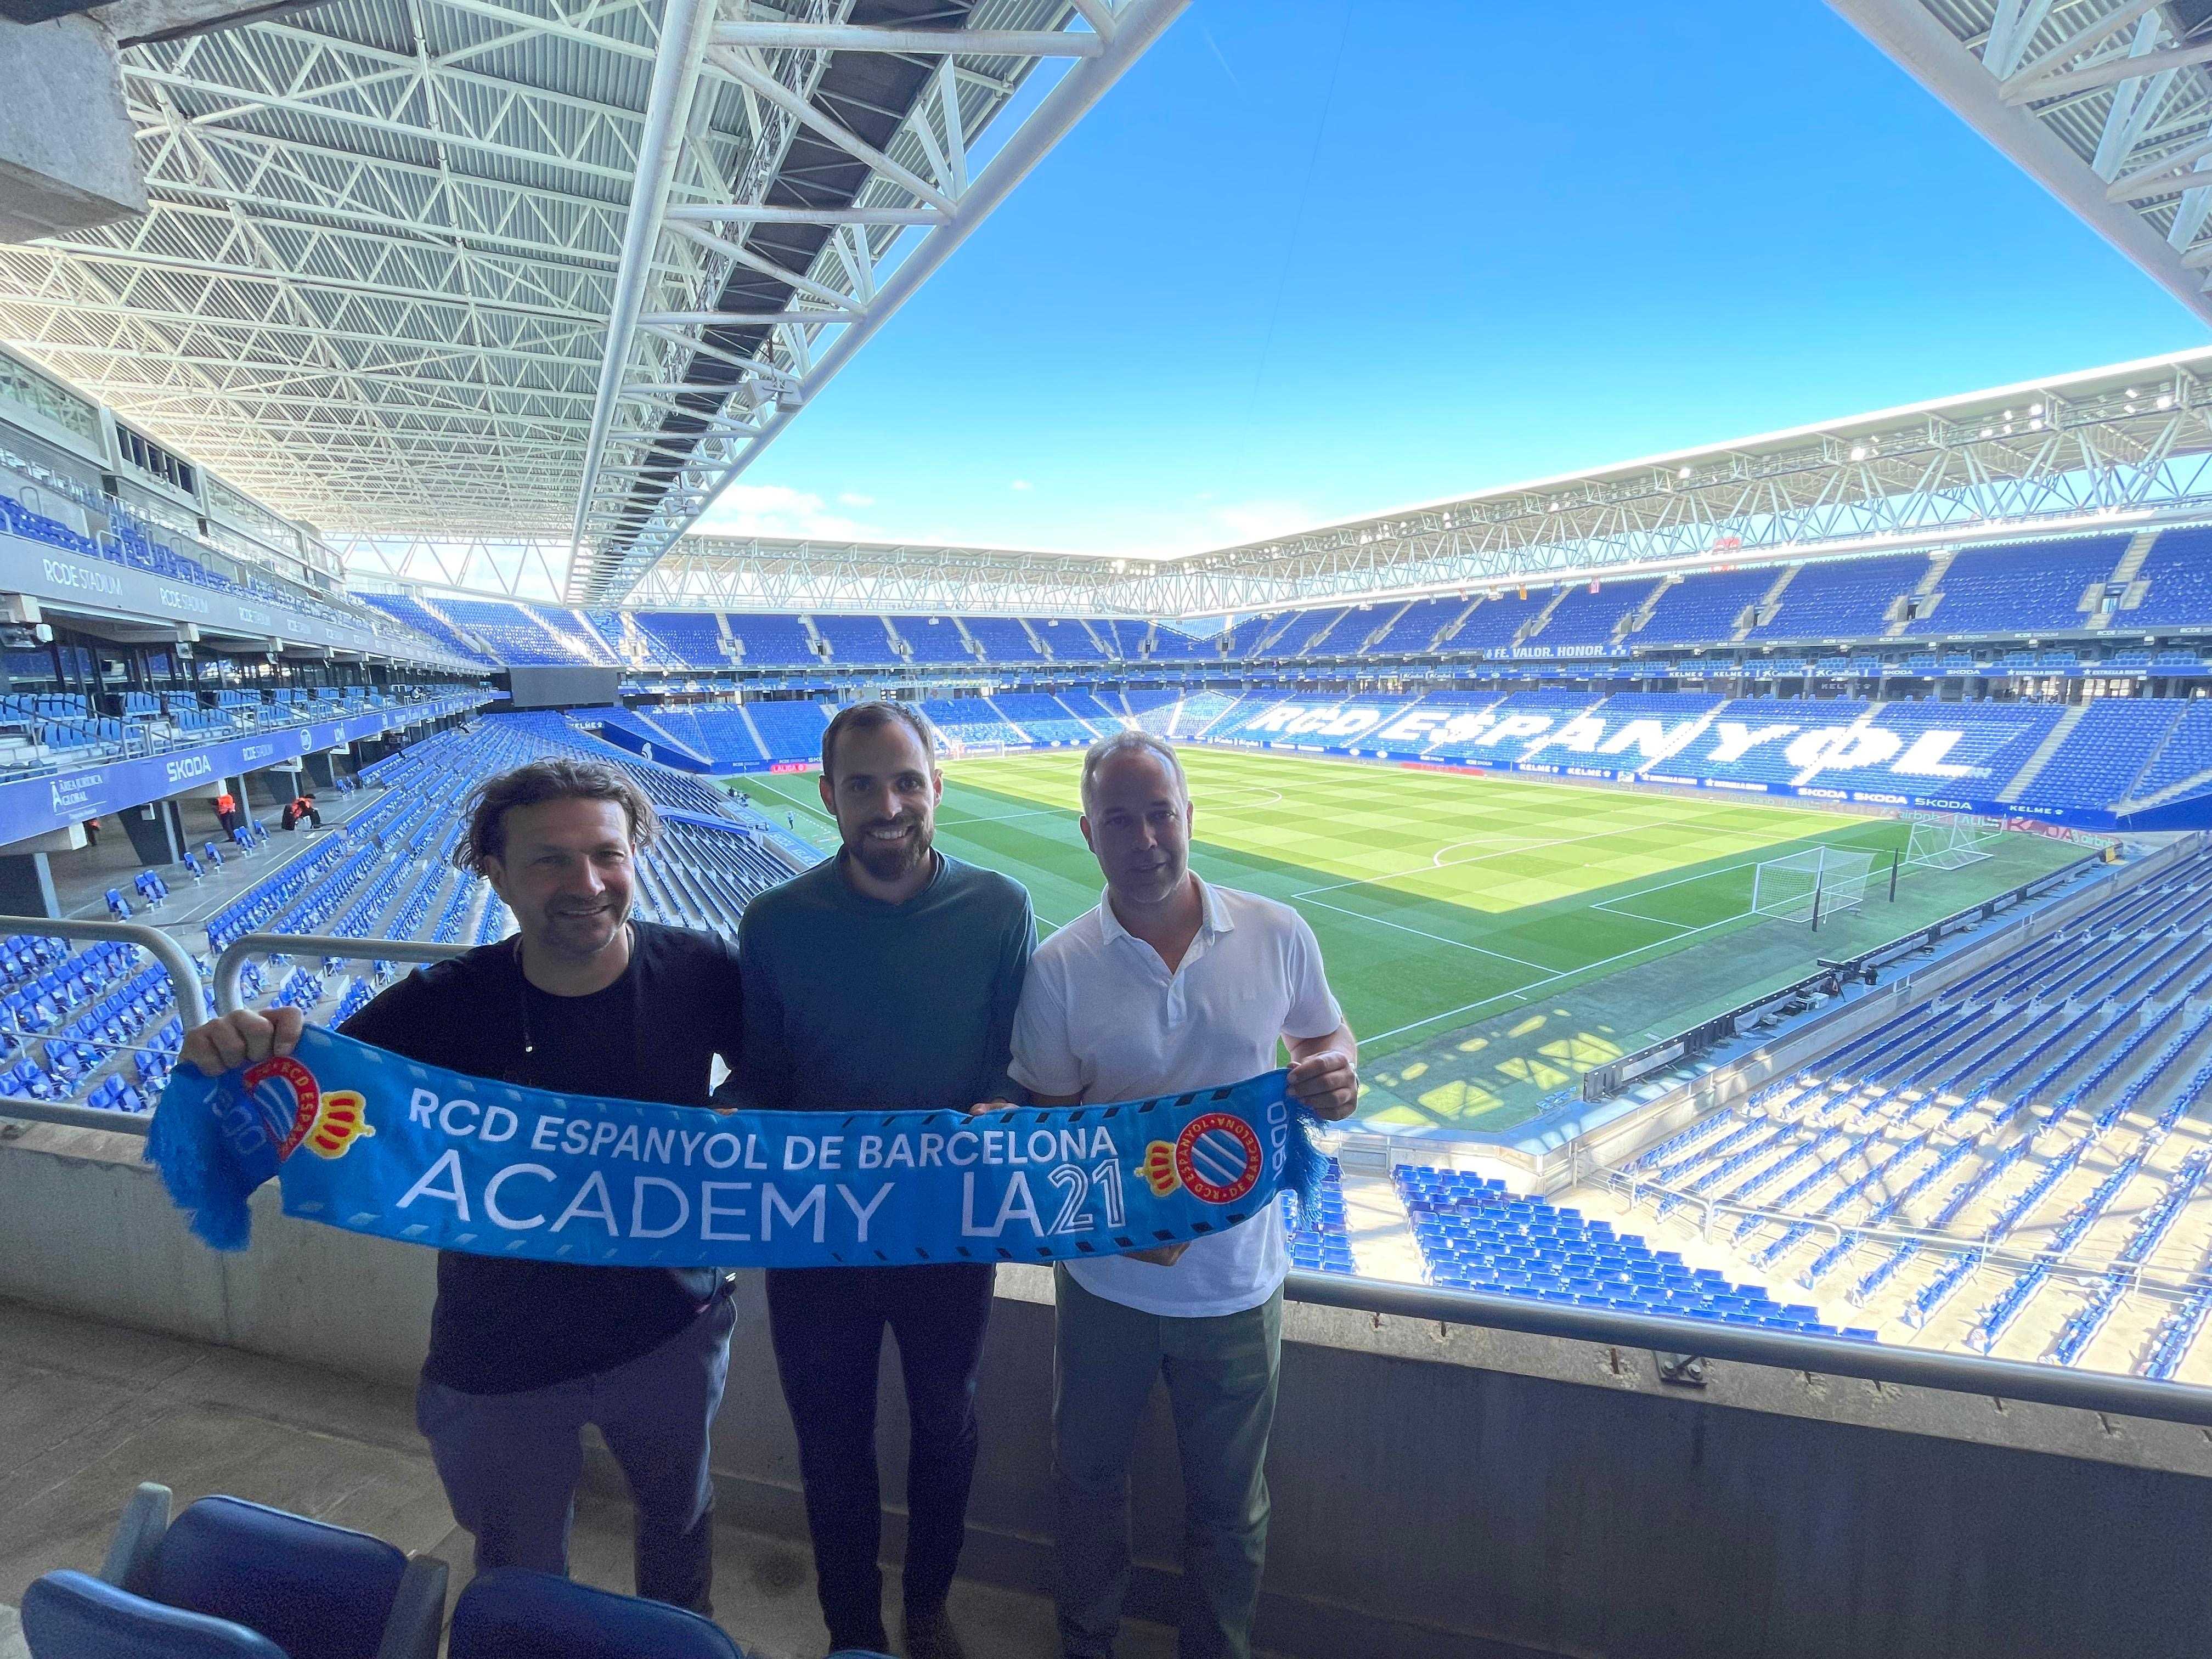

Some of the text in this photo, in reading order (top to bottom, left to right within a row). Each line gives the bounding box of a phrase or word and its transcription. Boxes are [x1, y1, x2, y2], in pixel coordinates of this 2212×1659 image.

[42, 558, 123, 596] RCDE STADIUM
[1494, 645, 1606, 658] FE. VALOR. HONOR.
[1246, 707, 1993, 779] RCD ESPANYOL
[166, 754, 212, 783] SKODA
[773, 765, 795, 773] LALIGA
[1520, 763, 1551, 772] KELME
[1567, 768, 1602, 777] KELME
[1798, 787, 1847, 799] SKODA
[1854, 792, 1908, 805] SKODA
[1915, 798, 1972, 811] SKODA
[2010, 805, 2052, 815] KELME
[1899, 809, 1940, 822] airbnb
[409, 1088, 1119, 1170] RCD ESPANYOL DE BARCELONA
[1267, 1100, 1288, 1181] 1900
[1178, 1120, 1220, 1200] RCD ESPANYOL
[1217, 1117, 1259, 1197] DE BARCELONA
[396, 1148, 896, 1243] ACADEMY
